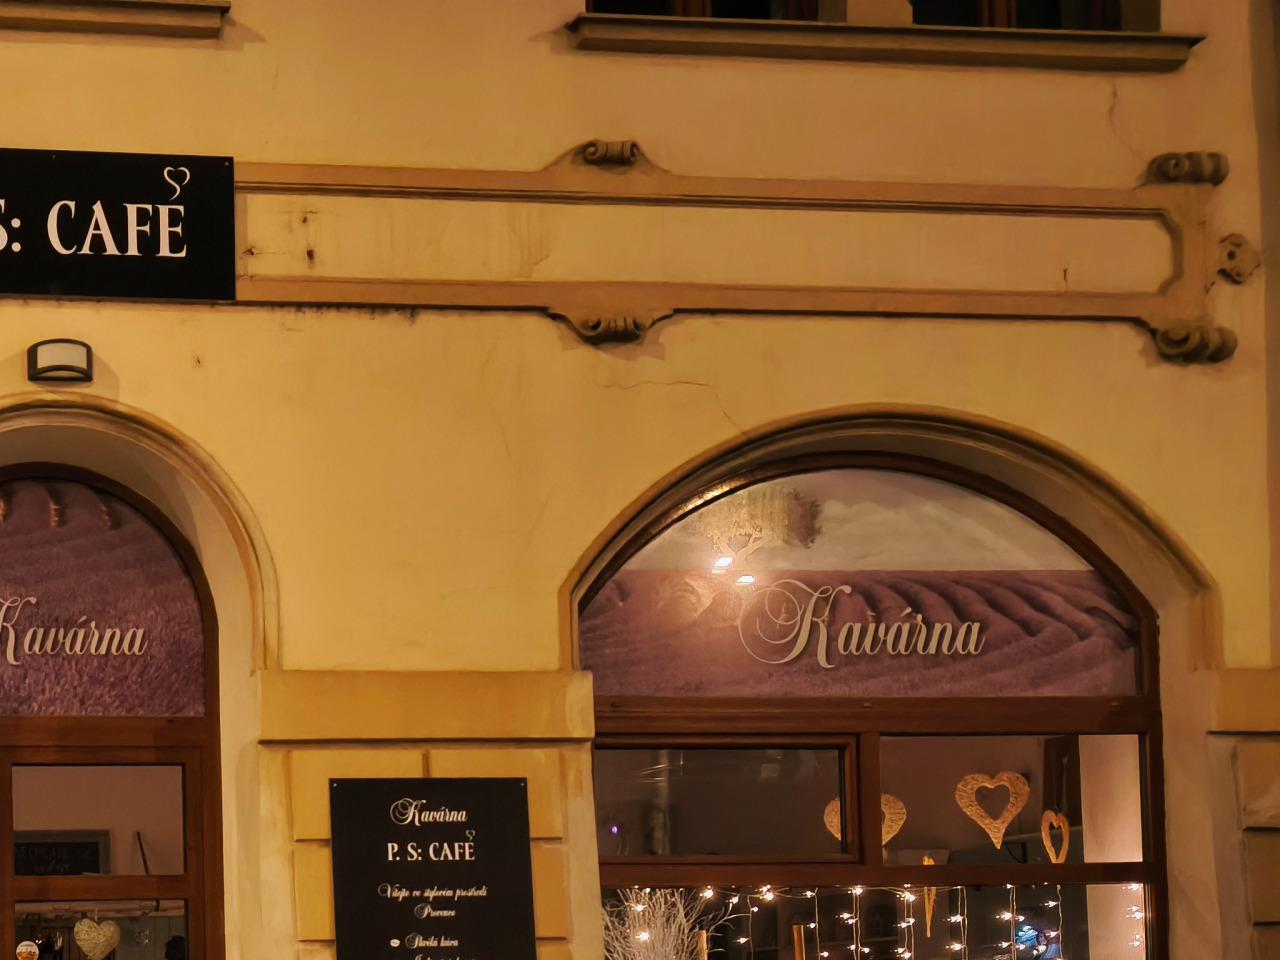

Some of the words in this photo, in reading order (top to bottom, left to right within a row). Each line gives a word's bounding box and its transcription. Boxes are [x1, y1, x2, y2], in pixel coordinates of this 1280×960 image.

[737, 579, 986, 668] Kavárna
[390, 798, 468, 826] Kavárna
[387, 842, 400, 861] P.
[407, 842, 422, 861] S:
